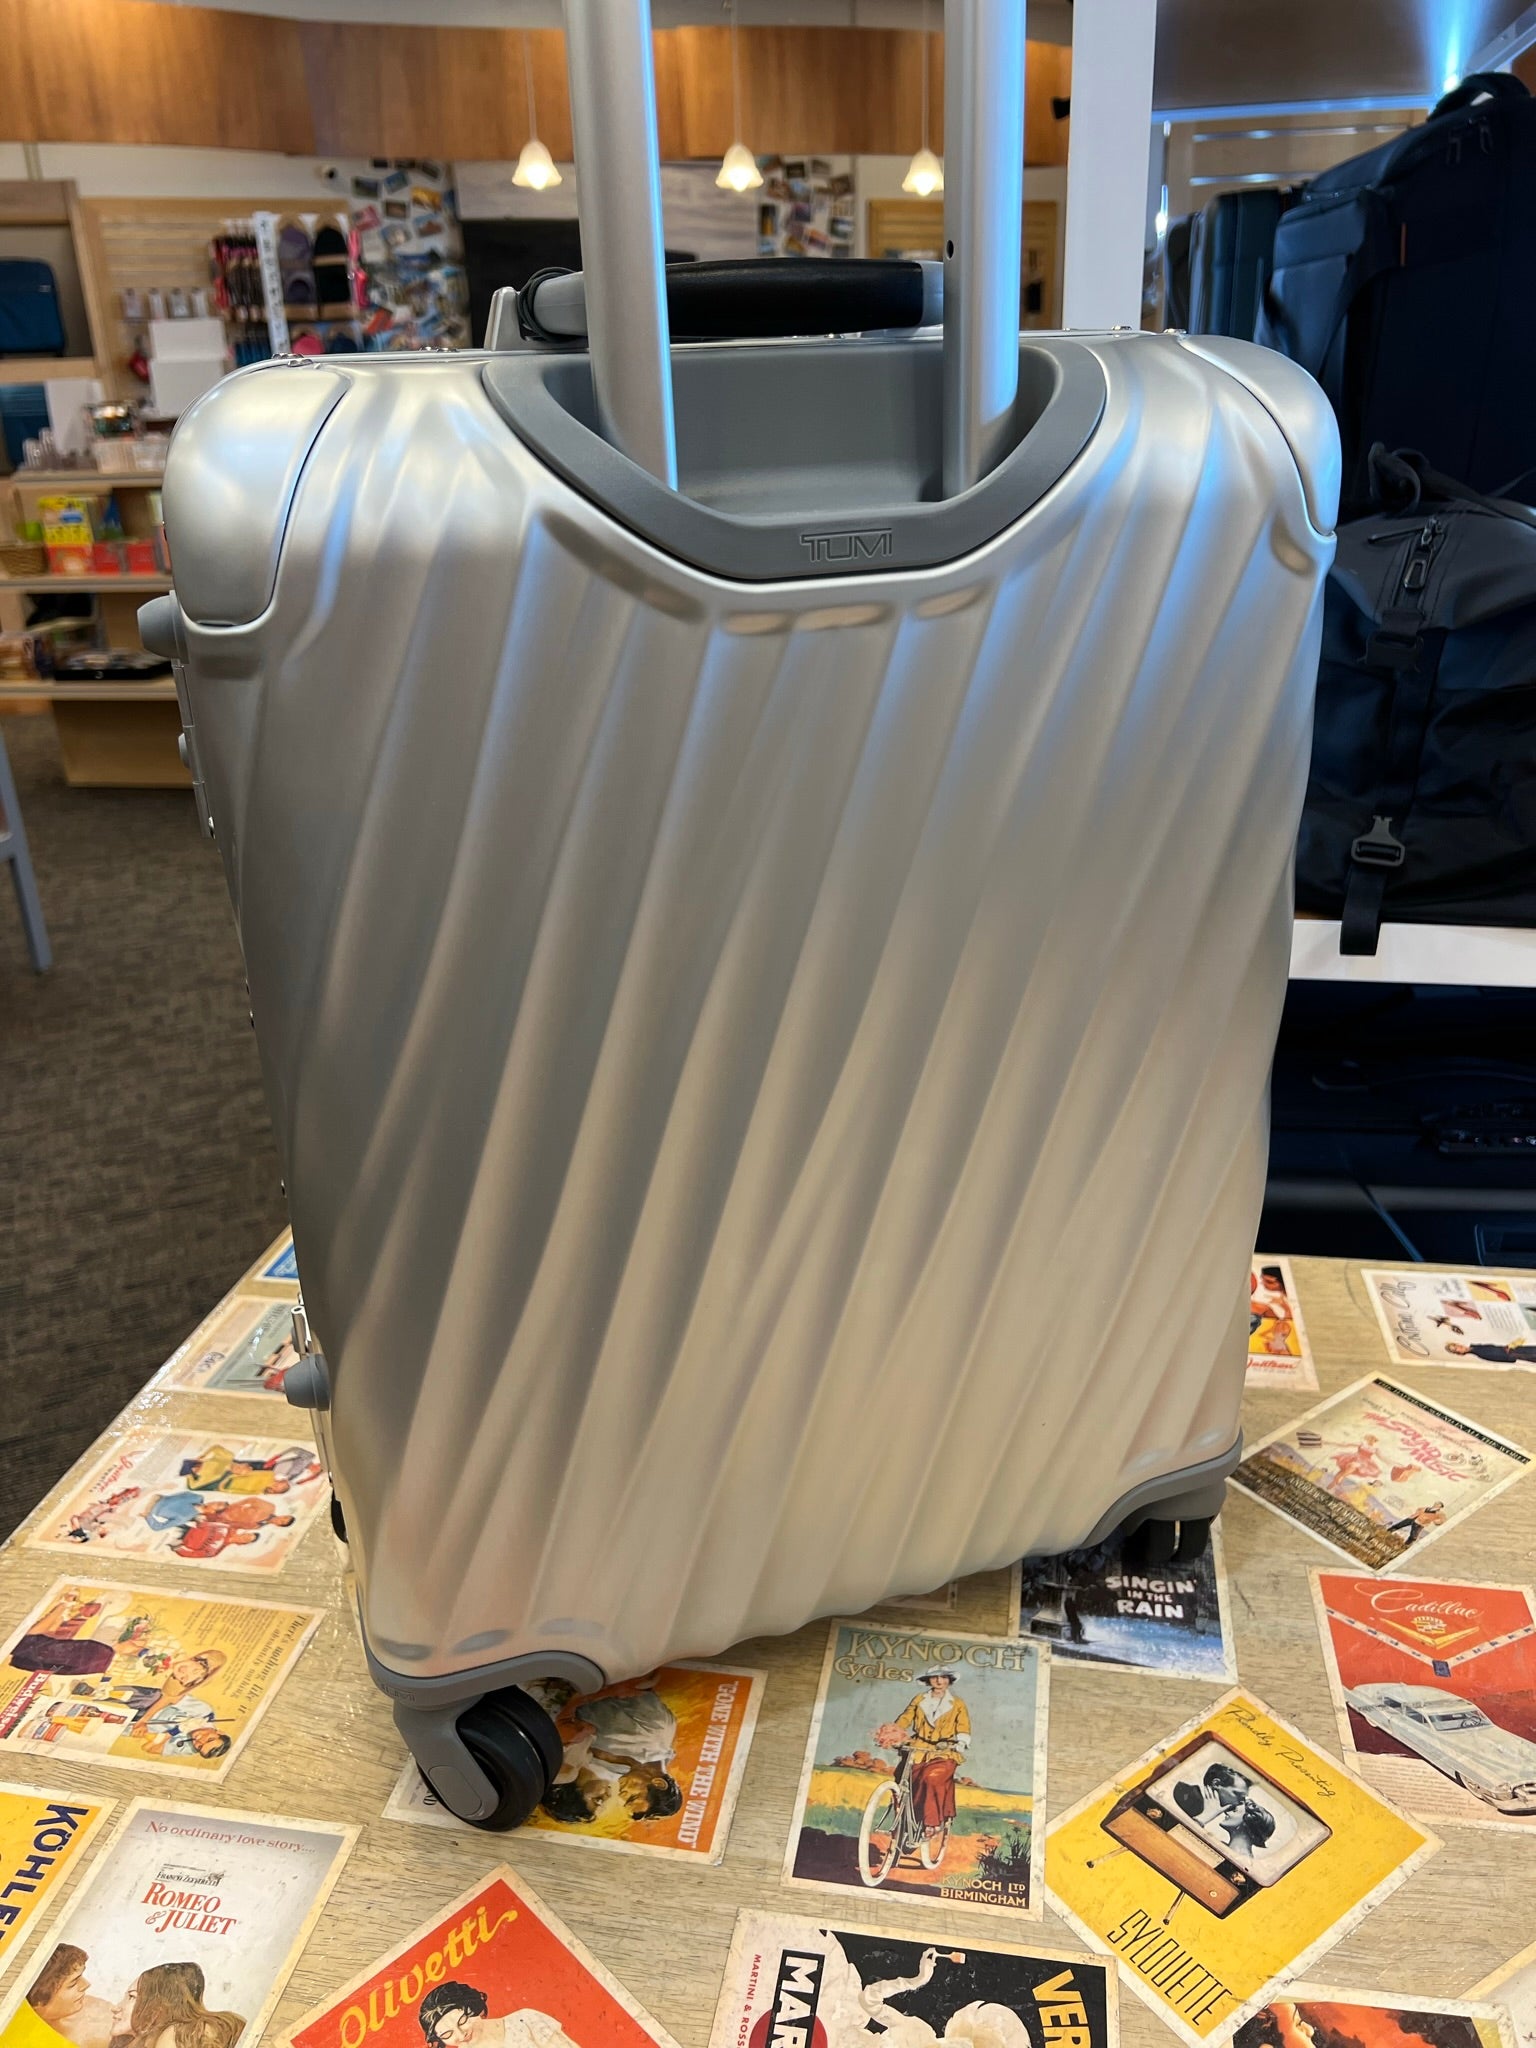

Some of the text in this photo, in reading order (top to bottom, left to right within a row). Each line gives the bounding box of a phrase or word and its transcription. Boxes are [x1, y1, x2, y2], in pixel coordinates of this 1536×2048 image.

[800, 527, 893, 563] TUMI
[1104, 1574, 1199, 1594] SINGIN'
[1127, 1589, 1173, 1603] IN THE
[1354, 1582, 1485, 1619] Cadillac
[1116, 1600, 1185, 1619] RAIN
[848, 1630, 1025, 1672] KYNOCH
[833, 1657, 914, 1683] Cycles
[699, 1724, 728, 1765] WITH
[1224, 1702, 1276, 1747] Proudly
[1275, 1744, 1336, 1797] Presenting
[689, 1765, 717, 1798] THE
[145, 1820, 168, 1834] No
[170, 1826, 236, 1844] ordinary
[237, 1834, 265, 1846] love
[0, 1804, 90, 1940] KÖHLE
[942, 1875, 1002, 1892] KYNOCH
[141, 1882, 221, 1914] ROMEO
[940, 1888, 1026, 1907] BIRMINGHAM
[339, 1906, 519, 2048] Olivetti
[1106, 1908, 1233, 2026] SYLOUETTE
[737, 1954, 762, 2048] MARTINI & ROSS
